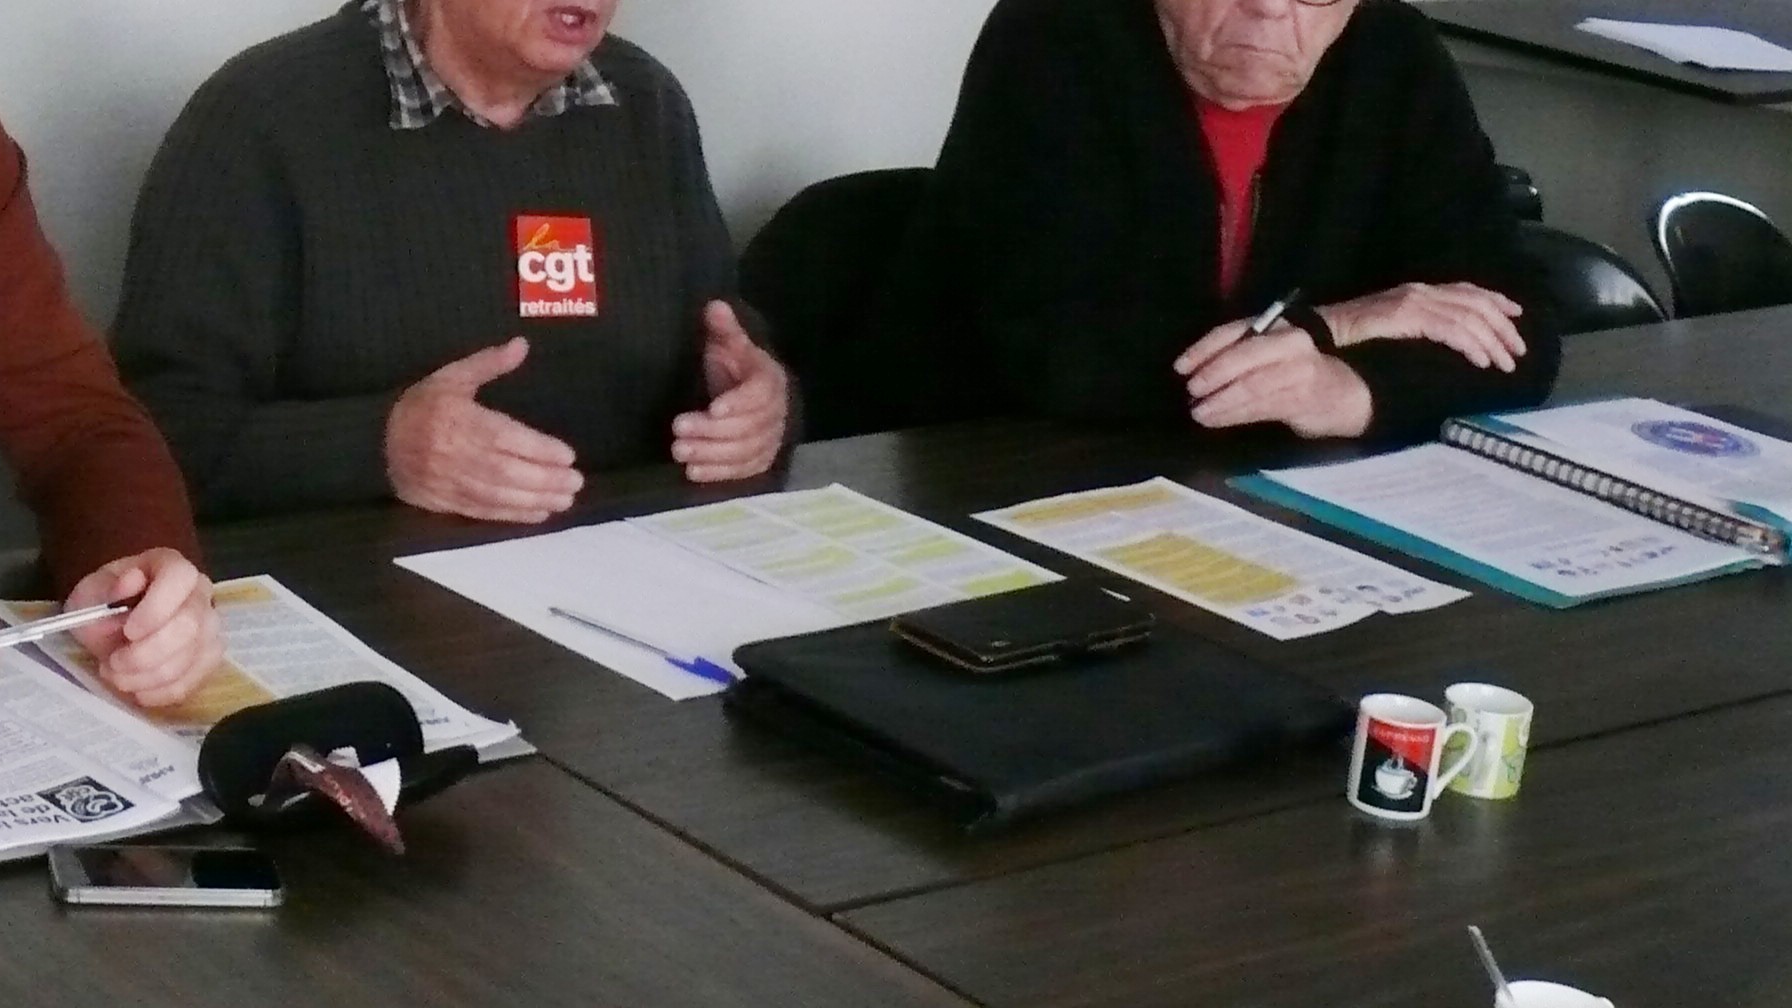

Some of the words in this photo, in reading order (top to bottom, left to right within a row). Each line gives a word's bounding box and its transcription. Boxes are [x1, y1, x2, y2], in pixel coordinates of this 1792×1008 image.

[518, 244, 595, 292] cgt
[519, 298, 597, 317] retraités
[22, 804, 51, 815] de
[14, 812, 71, 828] Vers
